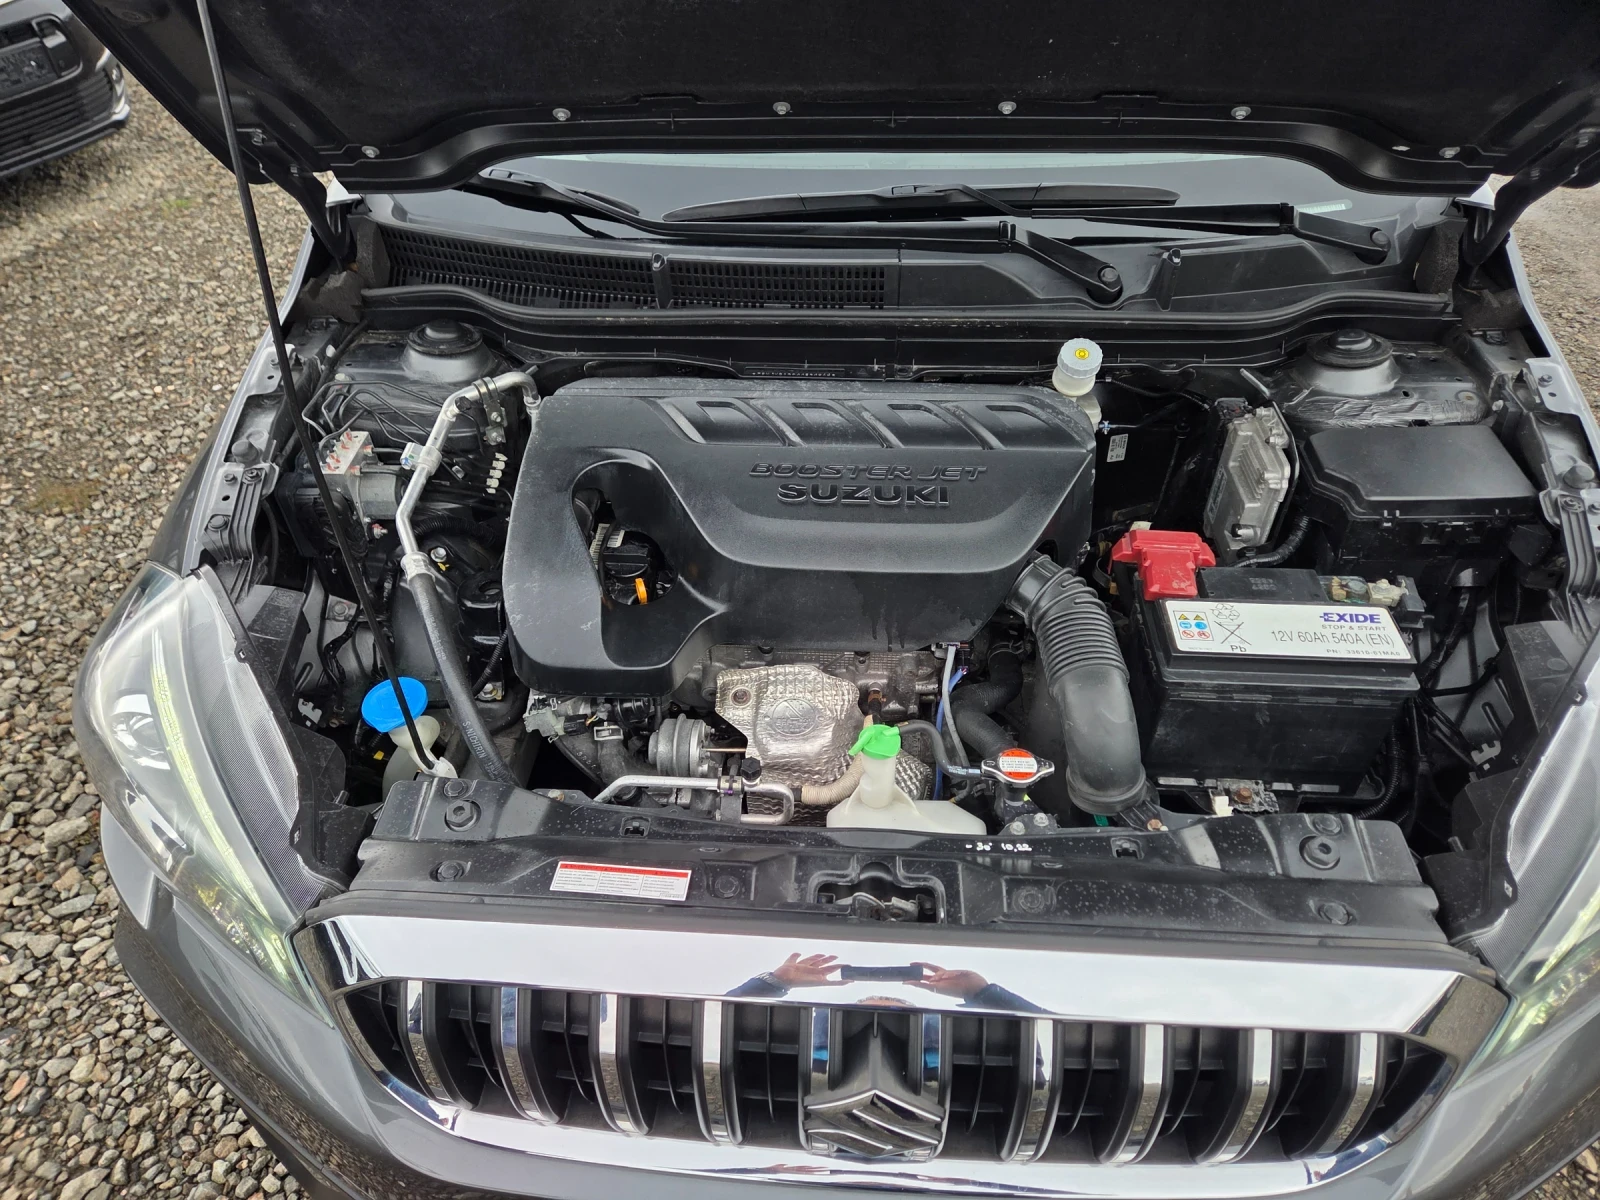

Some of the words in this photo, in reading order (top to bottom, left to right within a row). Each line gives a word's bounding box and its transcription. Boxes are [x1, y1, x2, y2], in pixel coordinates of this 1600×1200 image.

[777, 483, 949, 505] SUZUKI
[1320, 612, 1382, 624] EXIDE
[1271, 630, 1294, 642] 12V
[1298, 631, 1330, 643] 60Ah
[1331, 633, 1365, 645] 540A
[1365, 634, 1395, 648] (EN)
[1230, 644, 1247, 653] Pb
